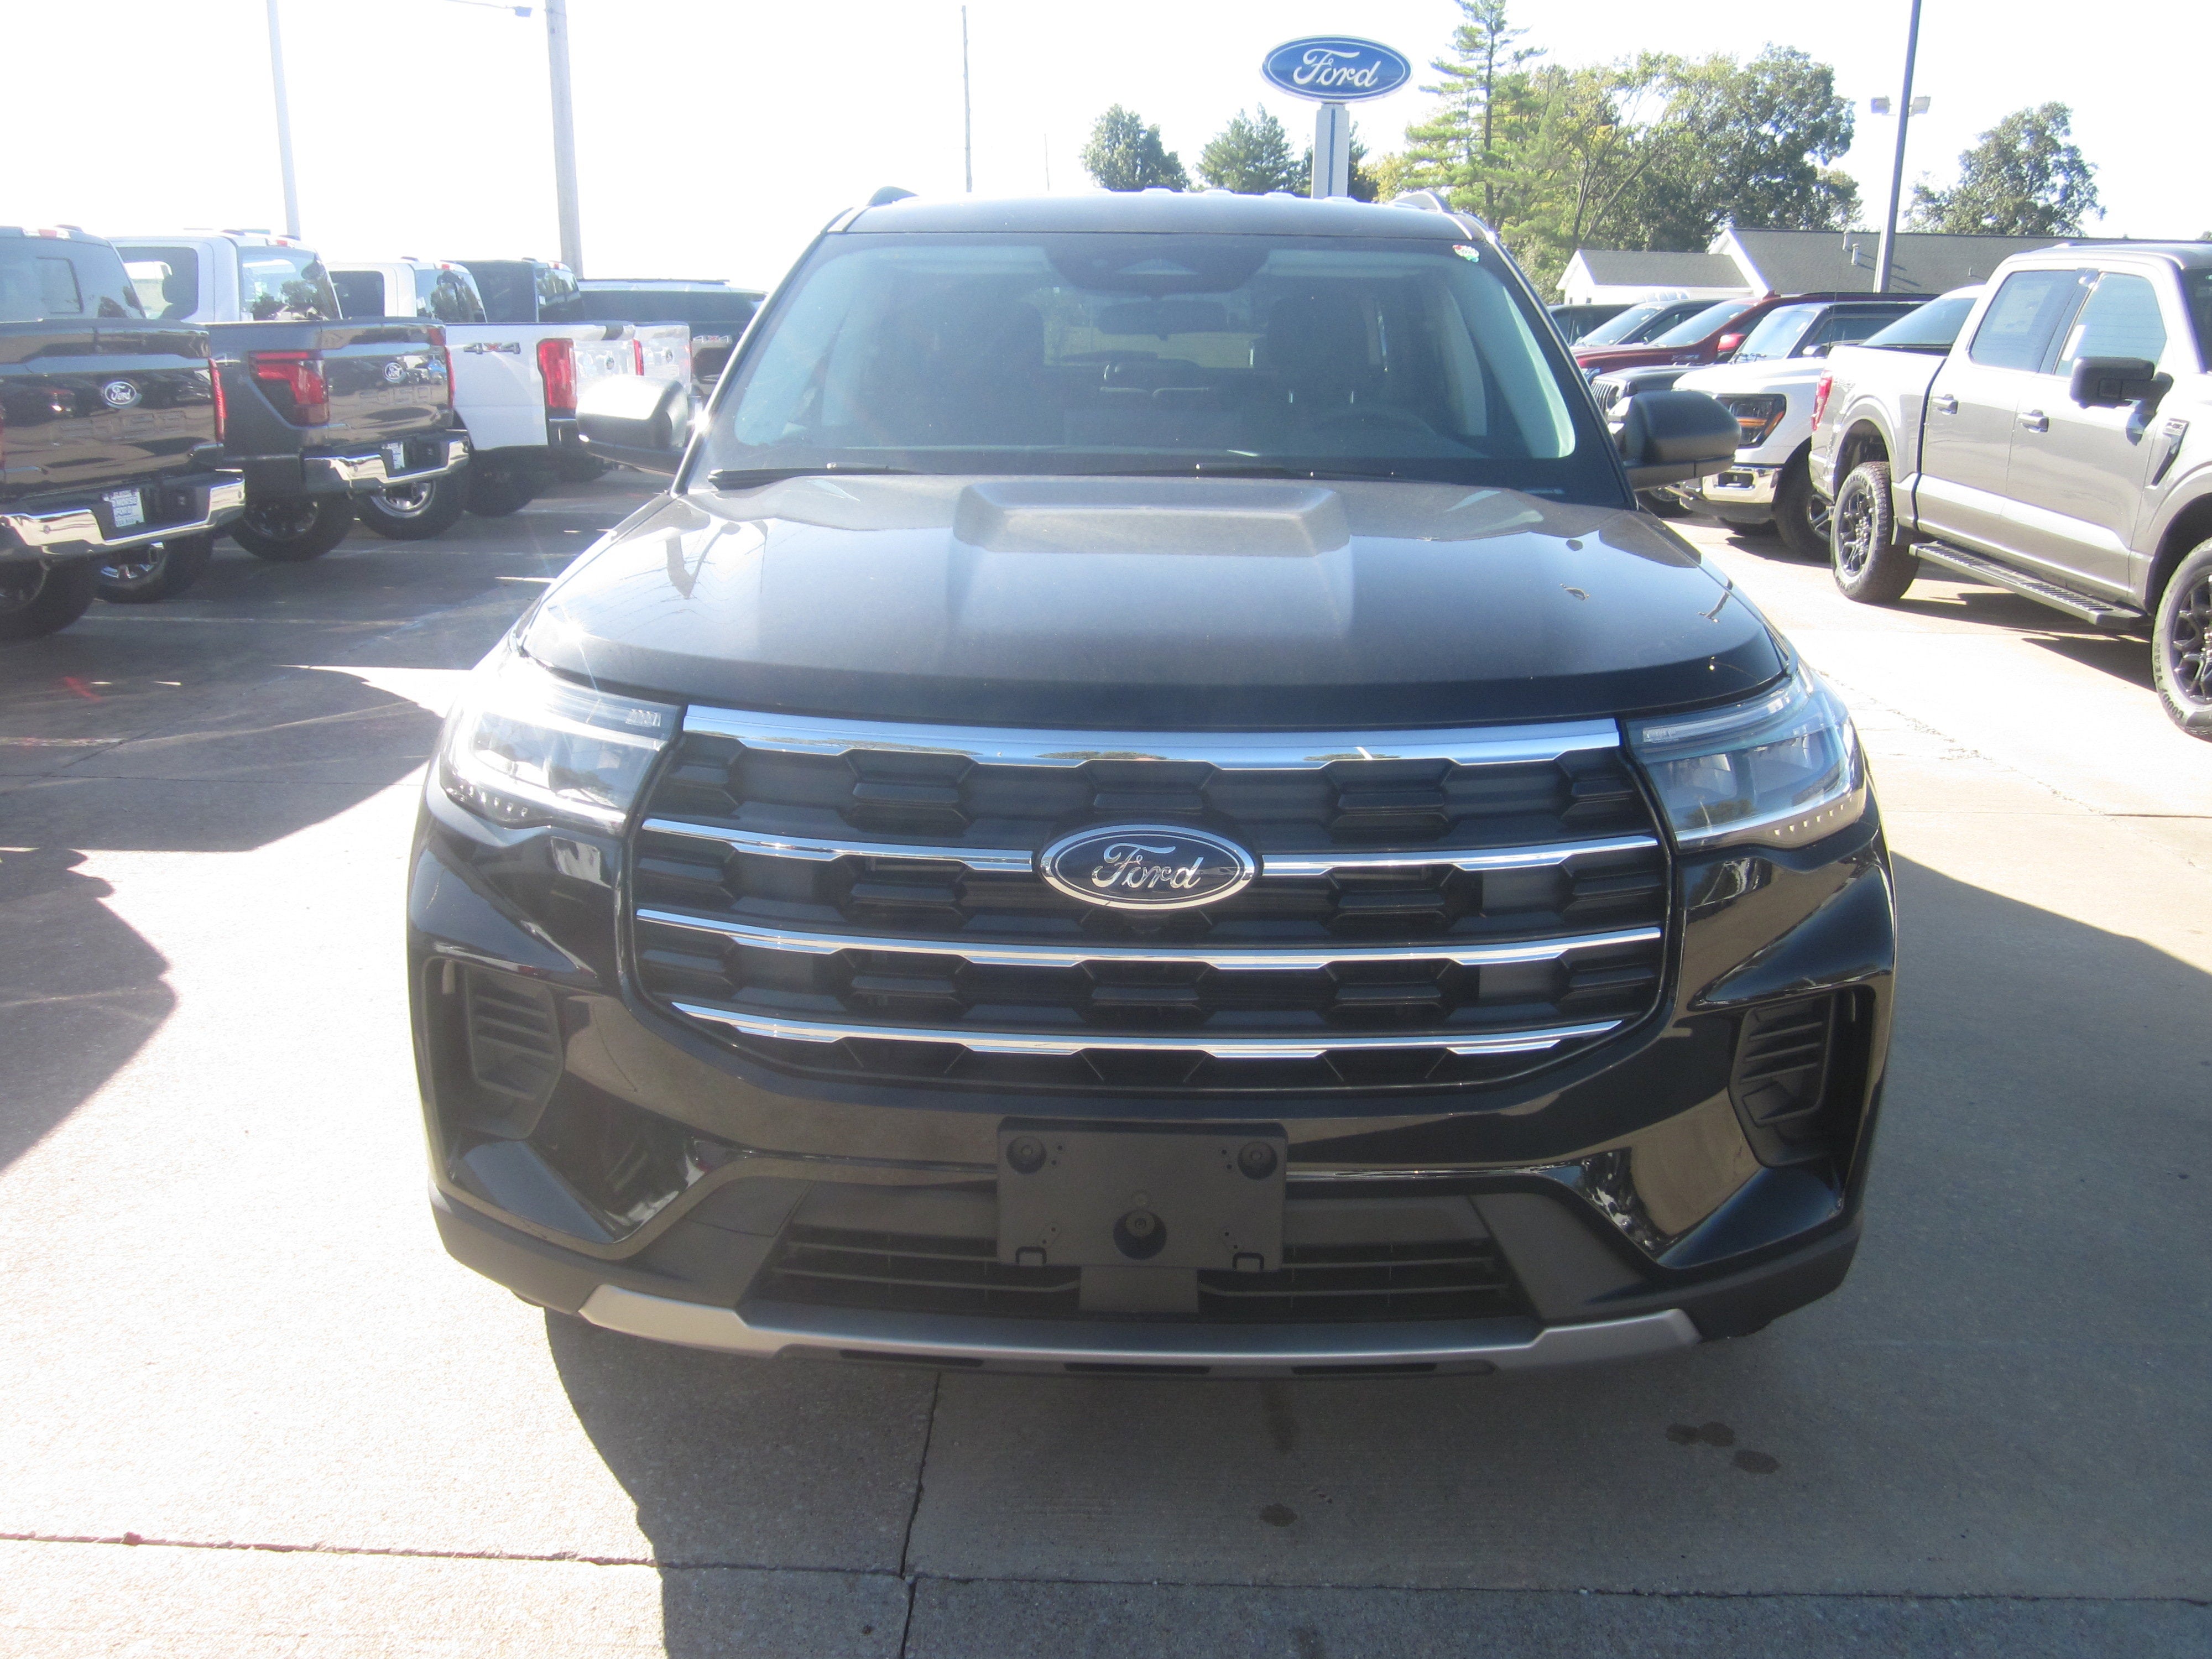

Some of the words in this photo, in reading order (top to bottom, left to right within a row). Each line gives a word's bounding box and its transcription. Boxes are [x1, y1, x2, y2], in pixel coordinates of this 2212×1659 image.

[1293, 48, 1381, 88] Ford
[111, 384, 132, 401] Ford
[1091, 842, 1204, 889] Ford
